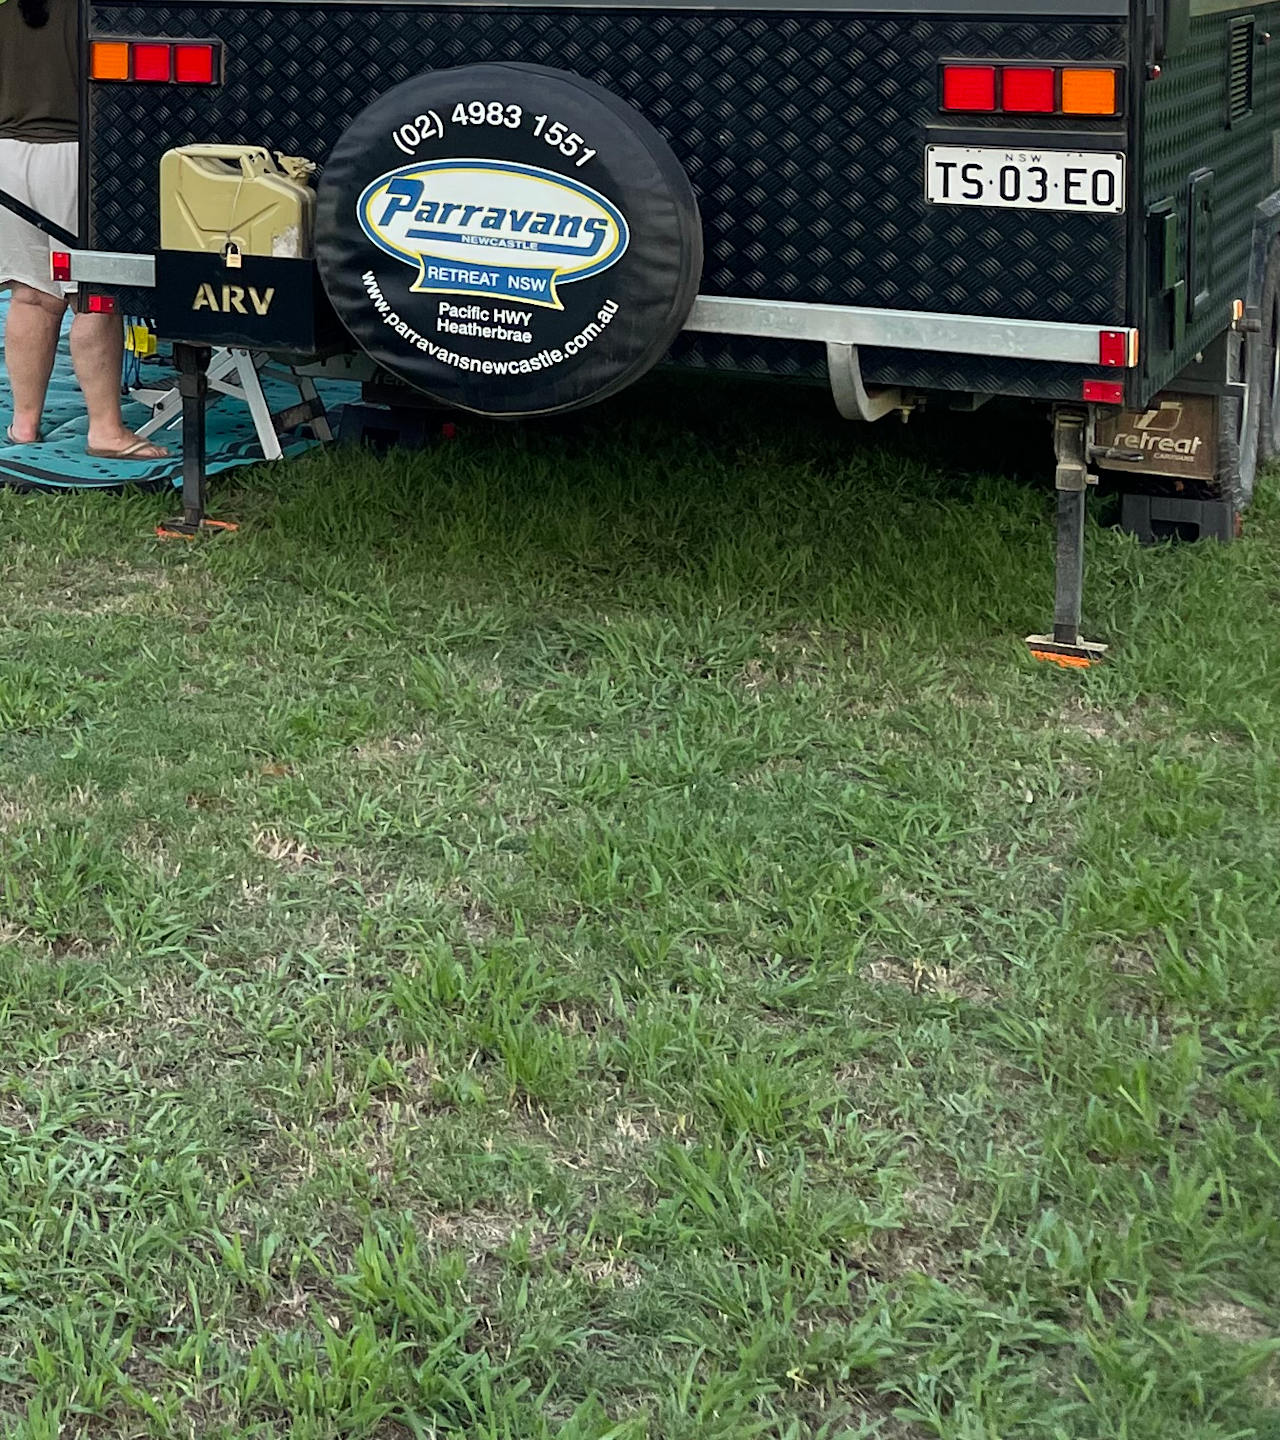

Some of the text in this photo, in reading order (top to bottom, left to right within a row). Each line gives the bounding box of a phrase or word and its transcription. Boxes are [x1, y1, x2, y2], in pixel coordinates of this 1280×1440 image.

[392, 101, 597, 167] (02) 4983 1551
[1005, 153, 1043, 162] NSW
[378, 176, 609, 250] Parravans
[461, 234, 539, 251] NEWCASTLE
[426, 264, 548, 293] RETREAT NSW
[192, 282, 275, 315] ARV
[361, 269, 620, 376] www.parravansnewcastle.com.au
[438, 301, 533, 328] Pacific HWY
[436, 317, 533, 344] Heatherbrae
[1113, 431, 1203, 455] retreat
